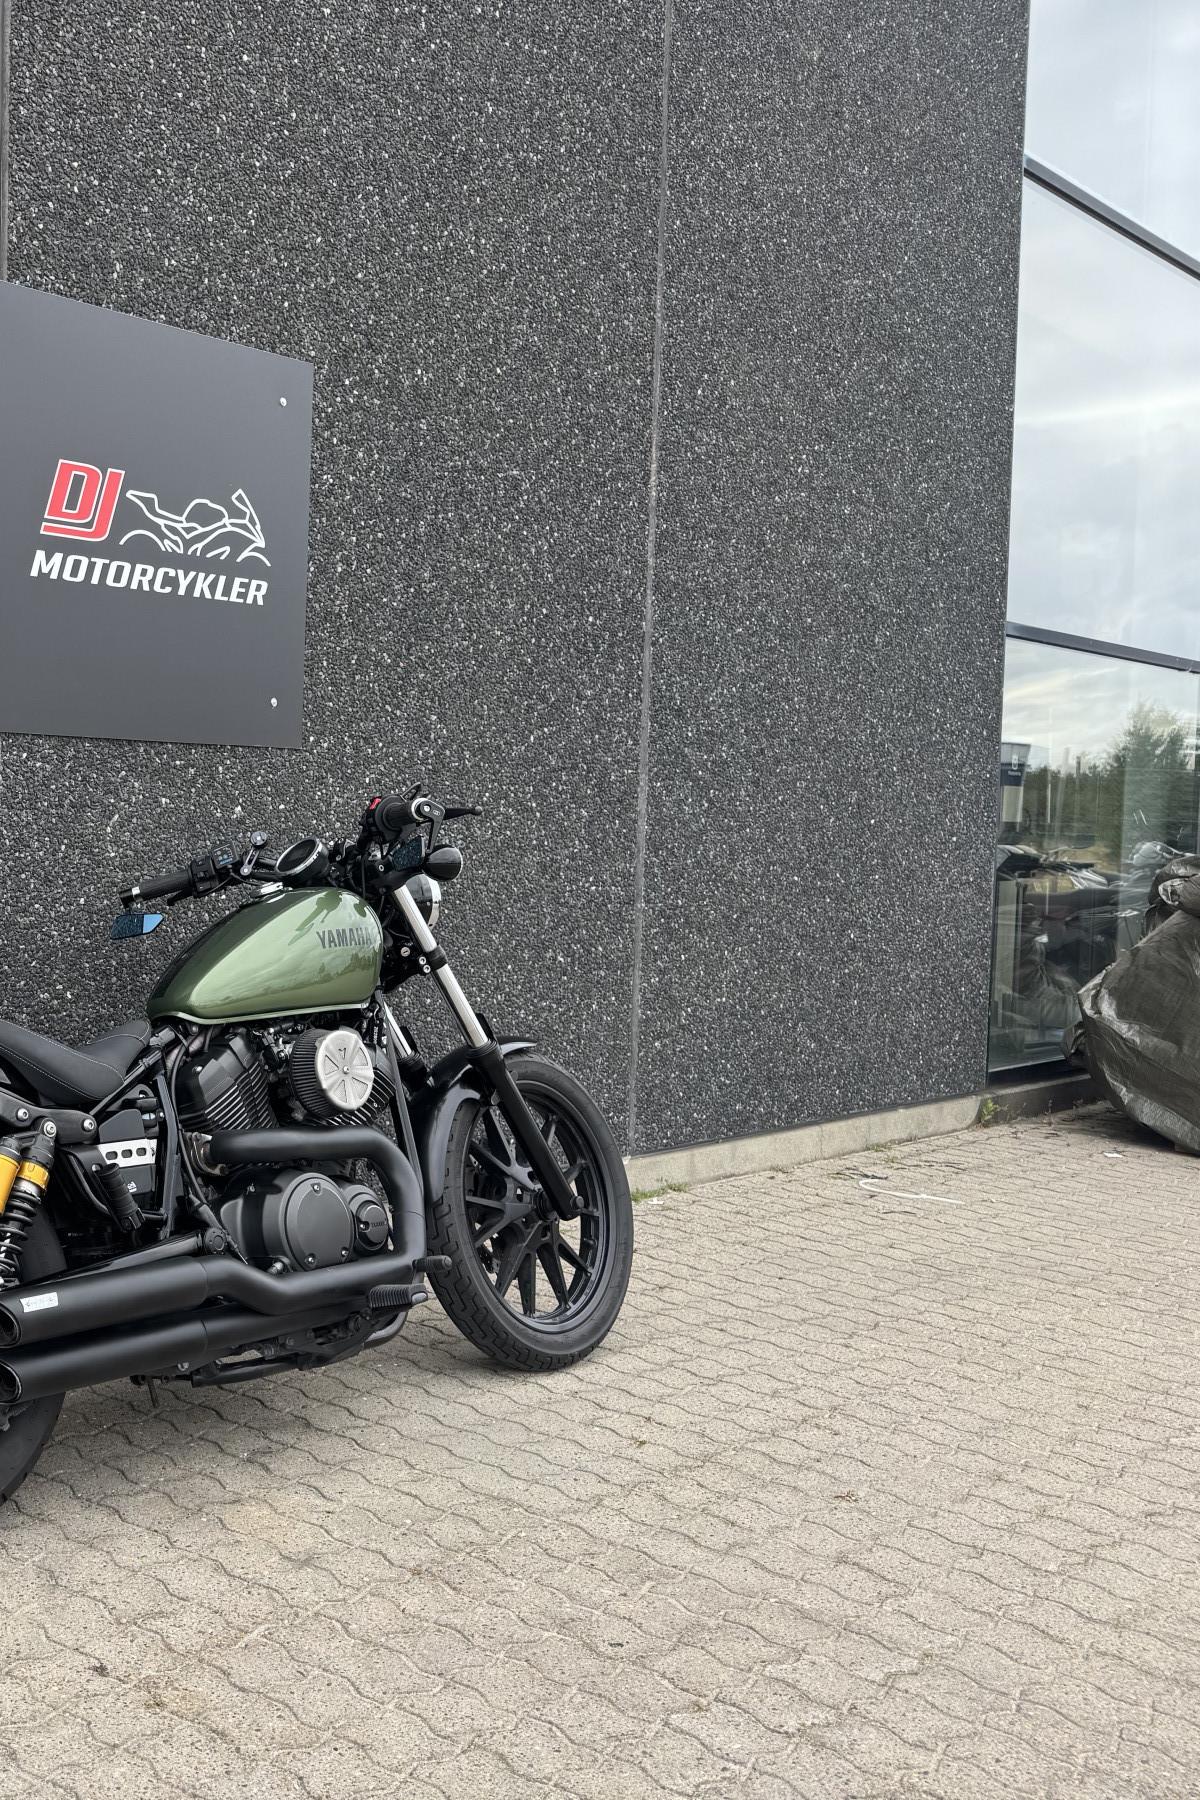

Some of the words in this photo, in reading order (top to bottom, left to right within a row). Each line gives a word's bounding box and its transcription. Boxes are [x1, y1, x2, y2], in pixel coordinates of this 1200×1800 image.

[39, 458, 126, 542] DJ
[29, 549, 269, 606] MOTORCYKLER
[316, 927, 373, 949] YAMAHA
